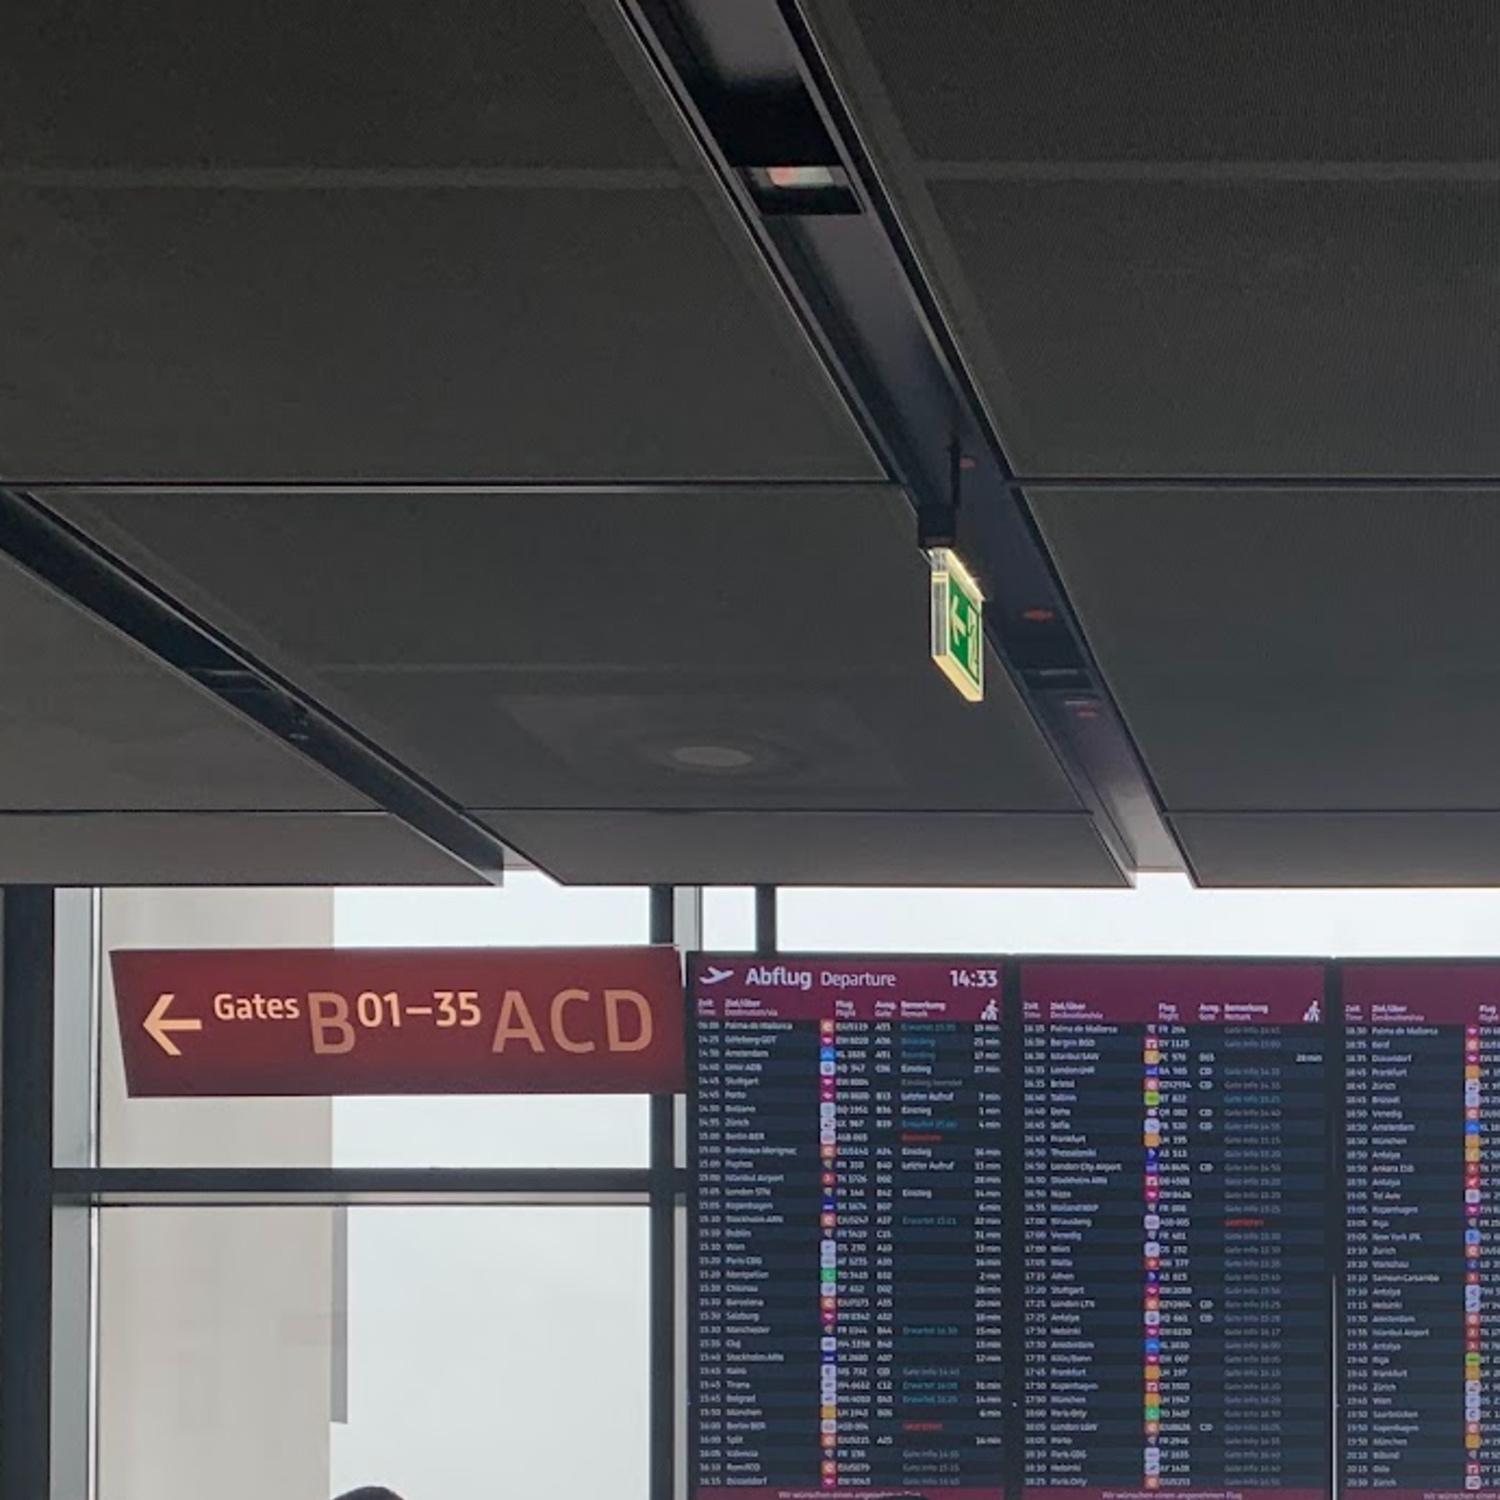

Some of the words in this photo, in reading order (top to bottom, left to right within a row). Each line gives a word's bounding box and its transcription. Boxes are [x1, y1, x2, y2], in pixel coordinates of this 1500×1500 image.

[745, 967, 812, 990] Abflug
[821, 971, 896, 989] Departure
[950, 970, 998, 987] 14:33
[214, 992, 300, 1022] Gates
[308, 992, 356, 1056] B
